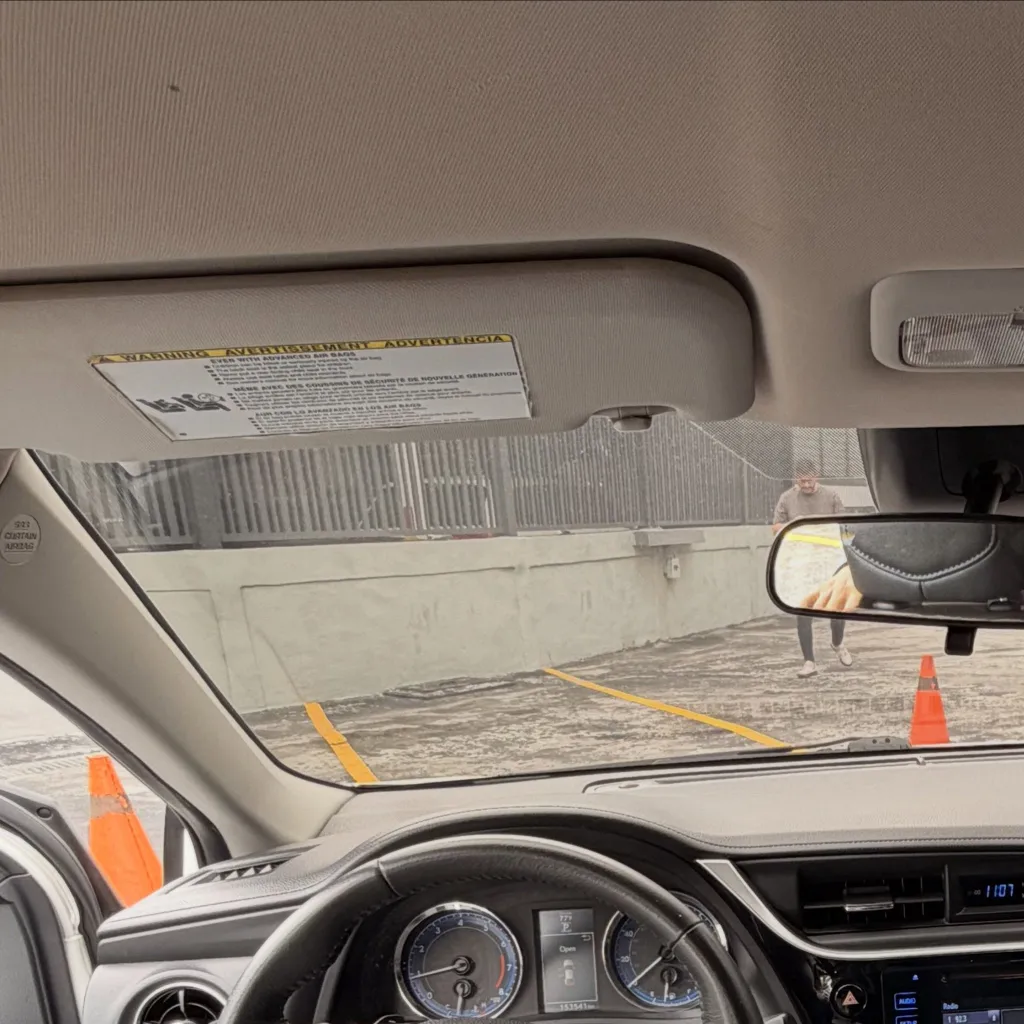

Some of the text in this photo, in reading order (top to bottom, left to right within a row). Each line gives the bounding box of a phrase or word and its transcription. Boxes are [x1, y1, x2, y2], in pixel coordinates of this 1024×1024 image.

[119, 334, 504, 362] WARNING AVERTISSEMENT ADVERTENCIA
[420, 374, 465, 383] NOUVELLE
[623, 930, 633, 938] 40
[559, 945, 577, 953] Open
[898, 997, 917, 1005] AUDIO
[942, 1002, 959, 1010] Radio
